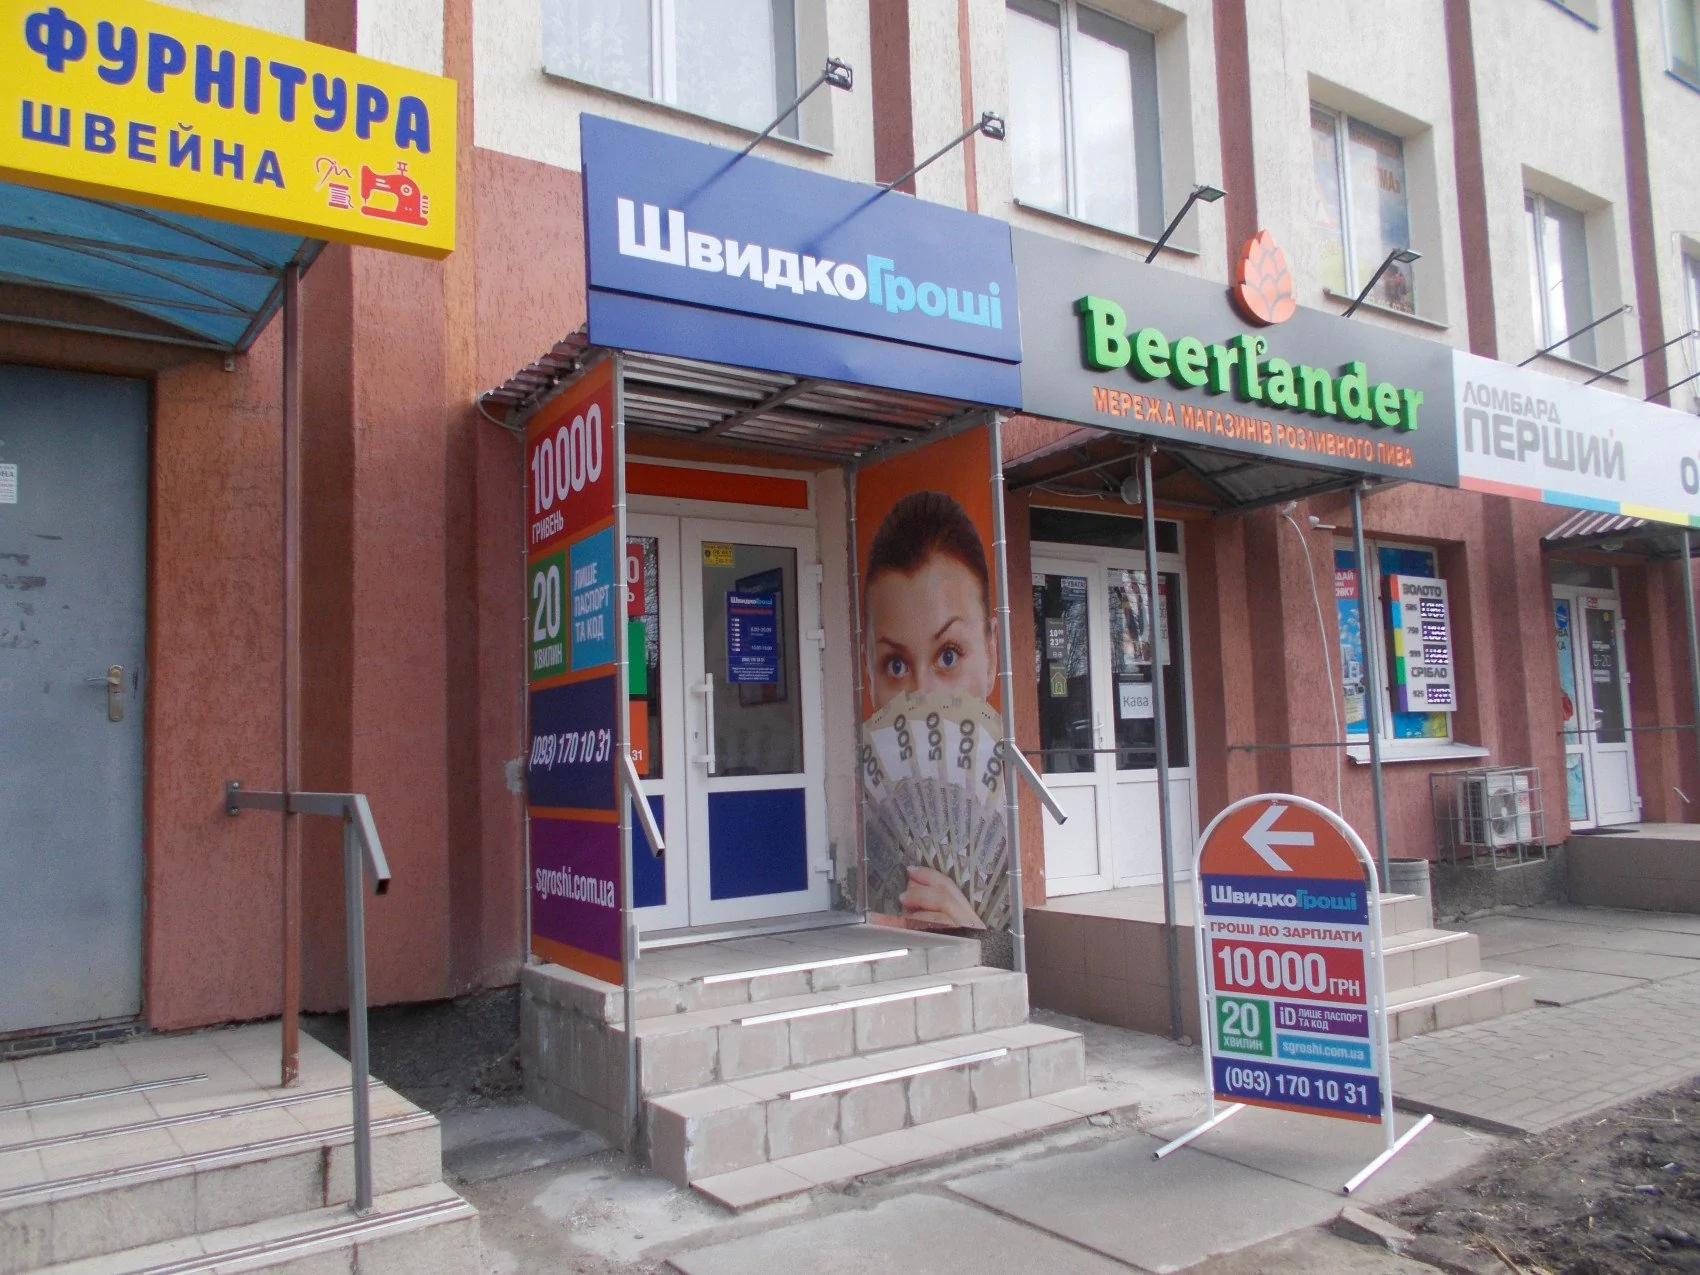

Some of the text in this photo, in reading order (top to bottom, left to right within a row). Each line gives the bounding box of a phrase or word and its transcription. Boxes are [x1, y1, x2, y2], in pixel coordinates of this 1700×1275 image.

[24, 7, 431, 154] ФУРНІТУРА
[21, 98, 286, 190] ШВЕЙНА
[617, 197, 1002, 329] ШвидкоГроші
[1080, 294, 1424, 431] Beerlander
[1462, 380, 1561, 424] ЛОМБАРД
[1092, 386, 1415, 468] МЕРЕЖА МАГАЗИНІВ РОЗЛИВНОГО ПИВА
[1463, 407, 1626, 481] ПЕРШИЙ
[532, 510, 564, 544] ГРИВЕНЬ
[574, 562, 598, 591] ЛИШЕ
[1403, 583, 1442, 597] ЗОЛОТО
[533, 565, 561, 642] 20
[574, 584, 610, 617] ПАСПОРТ
[576, 615, 604, 643] ТА КОД
[534, 643, 562, 670] ХВИЛИН
[1411, 667, 1448, 678] СРІБЛО
[529, 728, 611, 772] (093) 170 10 31
[894, 713, 913, 762] 500
[926, 712, 942, 761] 500
[957, 718, 975, 770] 500
[536, 865, 615, 908] sgroshi.com.ua
[1210, 884, 1357, 911] ШвидкоГроші
[1210, 921, 1363, 943] ГРОШІ ДО ЗАРПЛАТИ
[1329, 977, 1360, 997] ГРН
[1221, 1001, 1260, 1038] 20
[1298, 1008, 1363, 1024] ЛИШЕ ПАСПОРТ
[1299, 1018, 1329, 1031] ТА КОД
[1223, 1036, 1263, 1050] ХВИЛИН
[1283, 1041, 1365, 1060] sgroshi.com.ua
[1225, 1066, 1367, 1105] (093) 170 10 31
